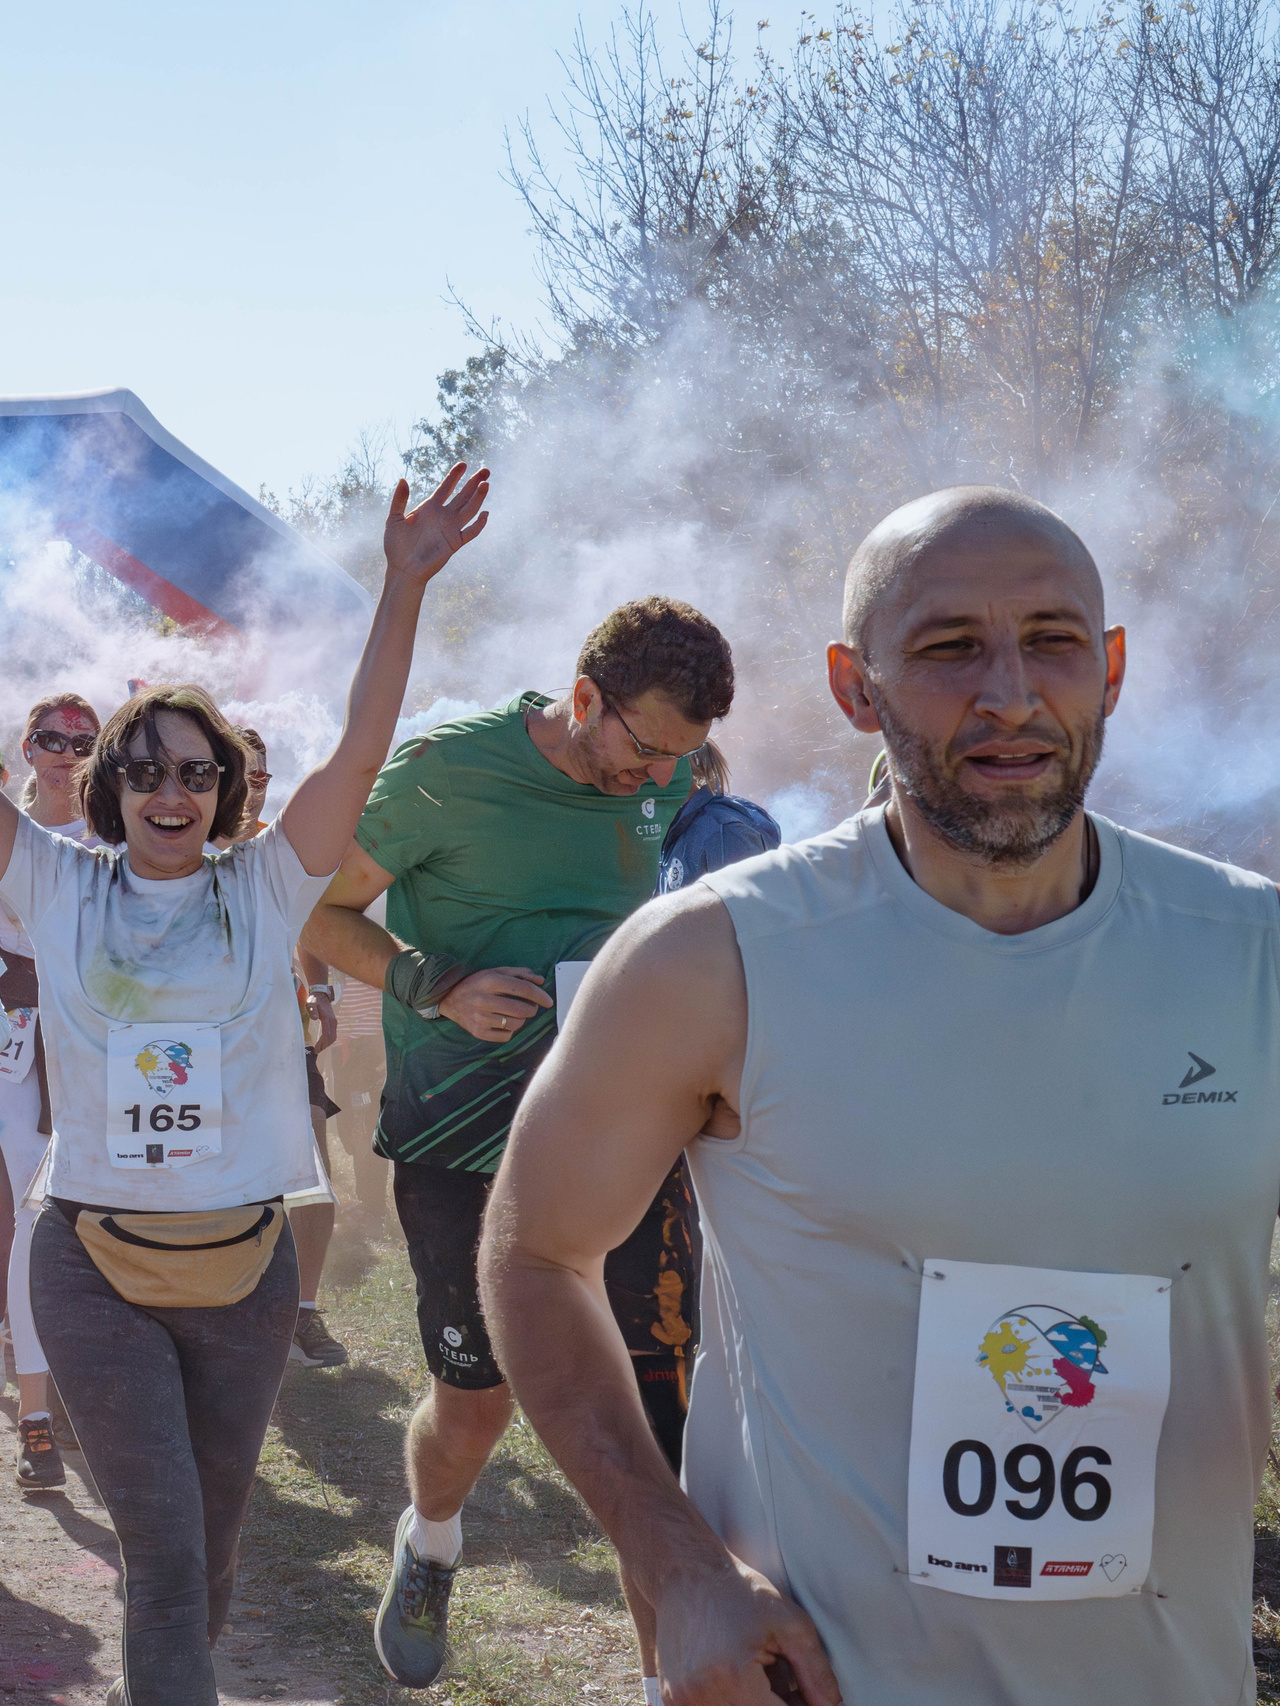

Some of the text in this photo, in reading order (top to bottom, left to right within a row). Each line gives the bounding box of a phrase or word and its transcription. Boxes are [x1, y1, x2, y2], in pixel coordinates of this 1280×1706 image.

[1162, 1090, 1239, 1105] DEMIX
[124, 1103, 202, 1133] 165
[438, 1342, 479, 1363] СТЕПЬ
[941, 1439, 1113, 1522] 096
